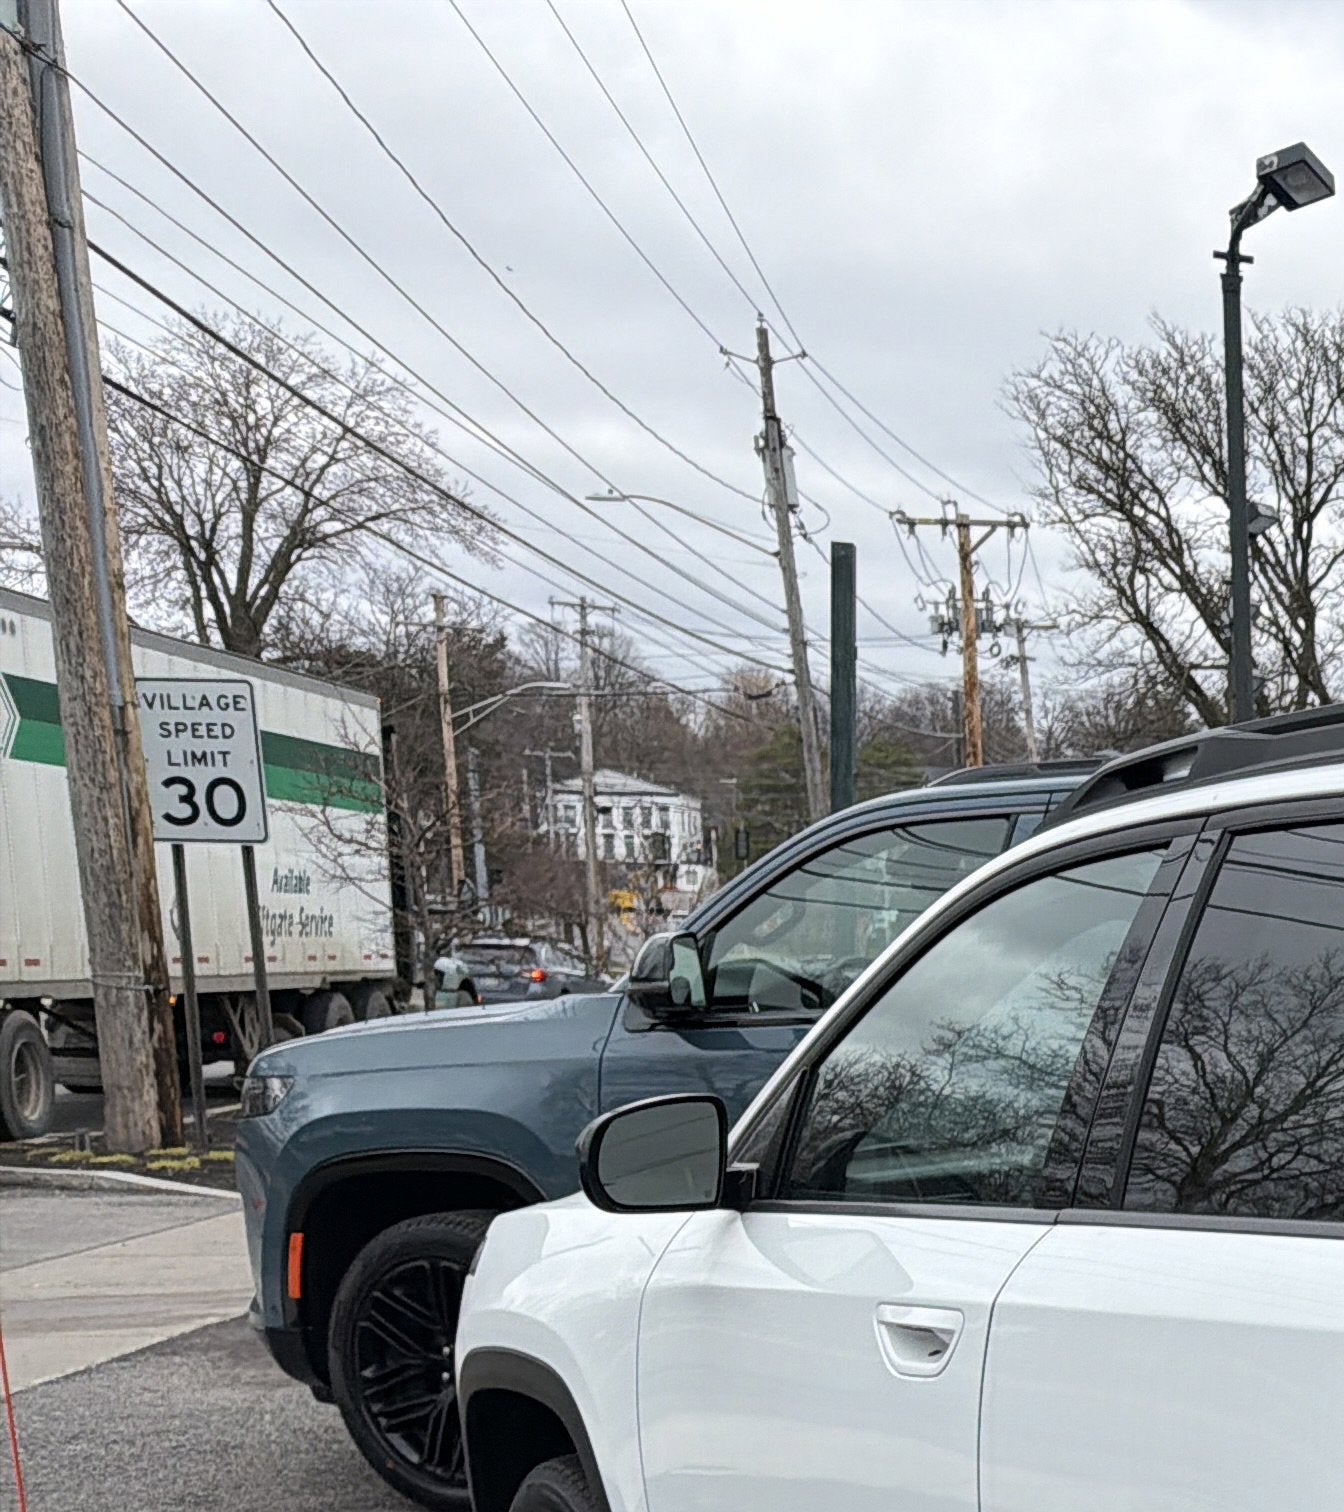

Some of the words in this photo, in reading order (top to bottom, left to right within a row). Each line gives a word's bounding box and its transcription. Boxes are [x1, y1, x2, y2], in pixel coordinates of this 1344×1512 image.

[142, 692, 248, 712] VILLAGE
[158, 721, 236, 739] SPEED
[166, 749, 232, 768] LIMIT
[160, 775, 247, 827] 30
[270, 866, 312, 896] Available
[298, 905, 334, 938] Service
